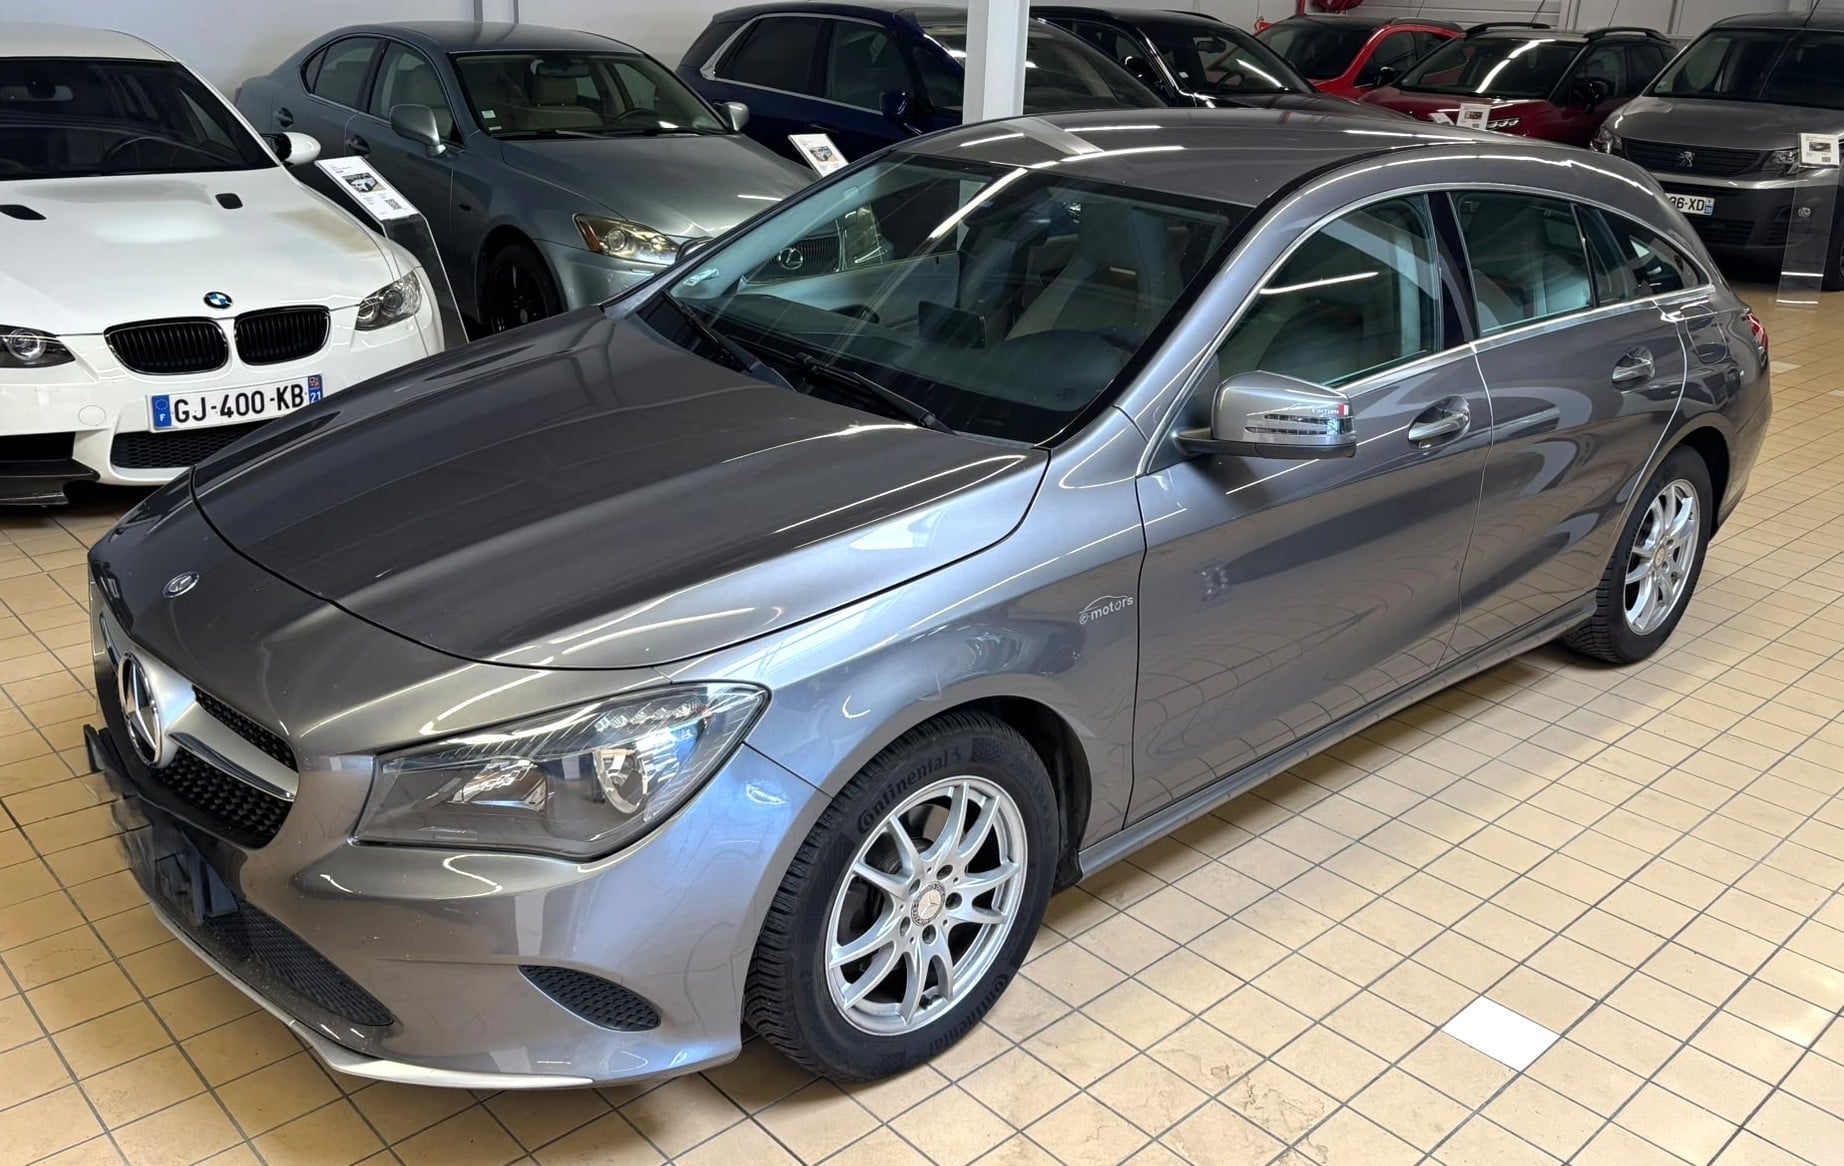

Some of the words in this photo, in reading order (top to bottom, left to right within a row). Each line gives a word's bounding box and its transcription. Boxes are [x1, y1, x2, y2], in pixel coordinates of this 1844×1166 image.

[173, 384, 304, 423] GJ-400-KB
[310, 391, 321, 403] 21
[159, 413, 166, 422] F
[858, 750, 949, 834] Continental
